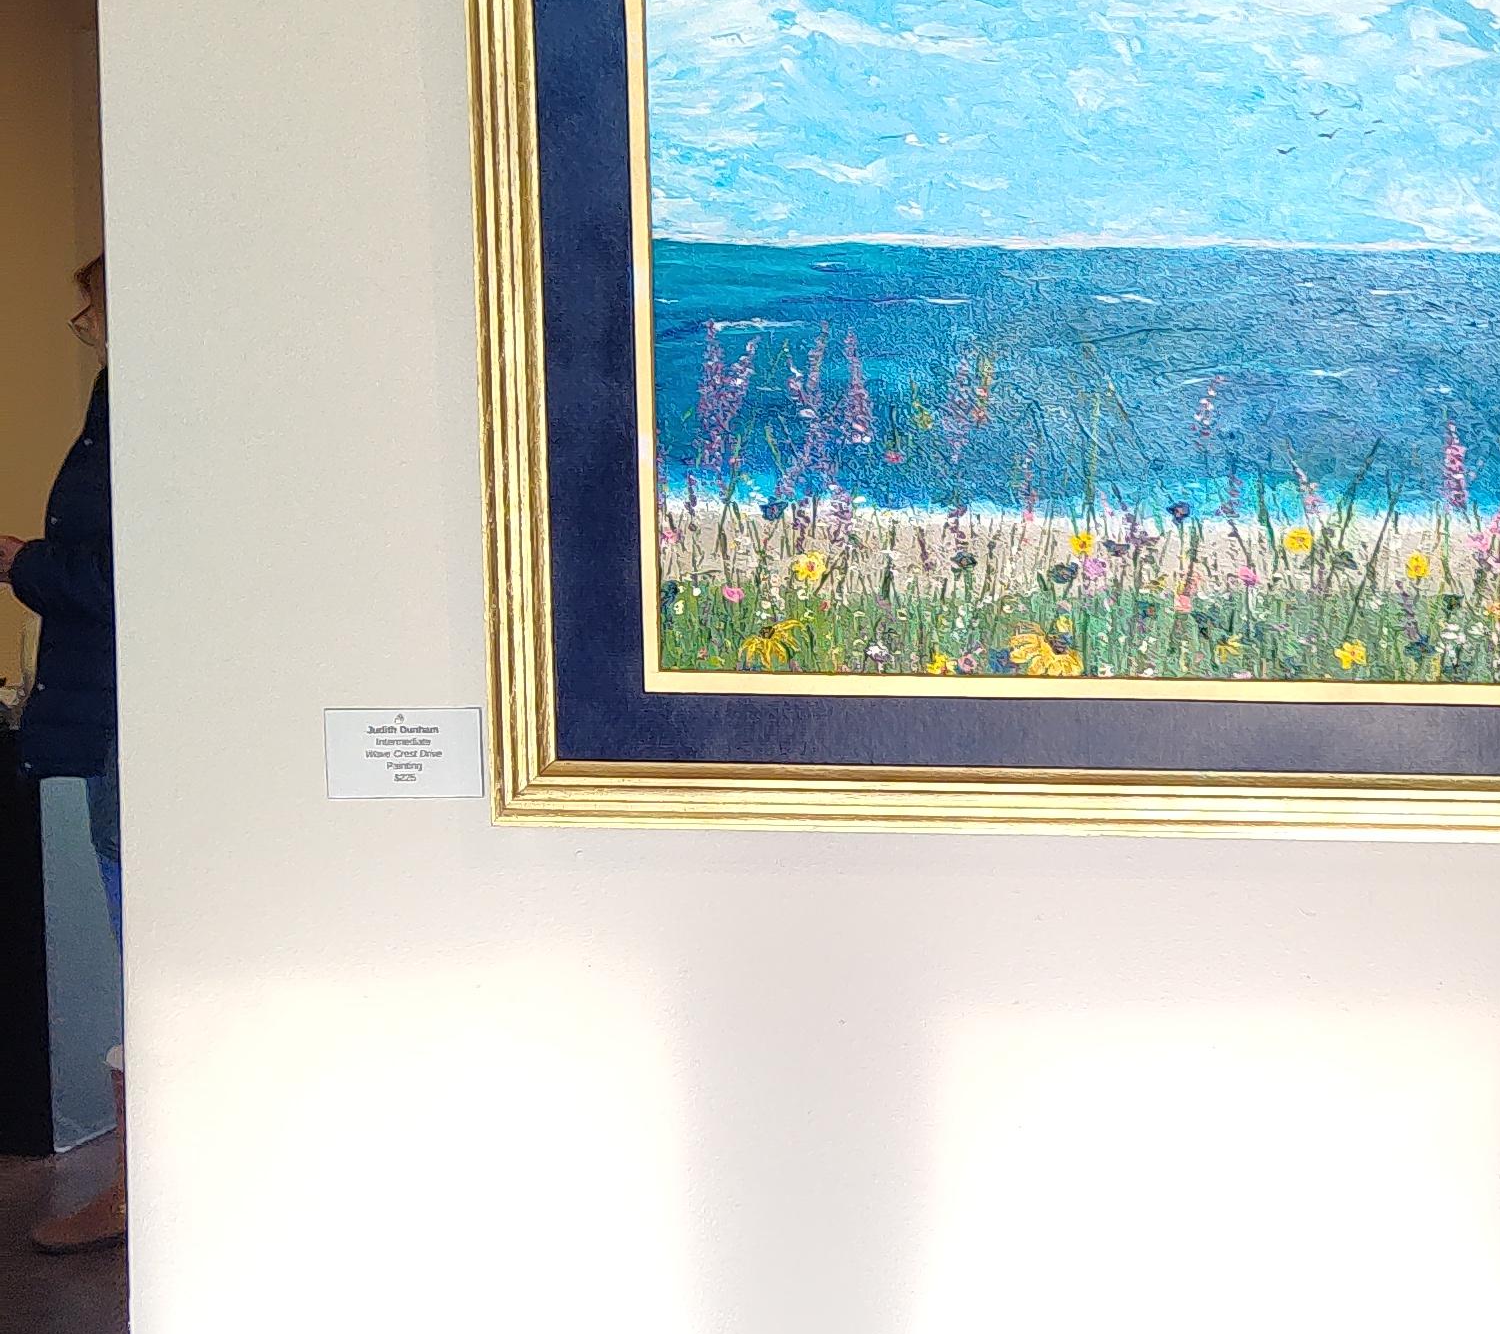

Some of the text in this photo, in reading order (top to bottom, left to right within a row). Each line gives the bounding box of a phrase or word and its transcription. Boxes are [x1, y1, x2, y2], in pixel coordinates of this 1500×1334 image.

[367, 726, 396, 734] Judith
[366, 750, 390, 758] Wave
[387, 762, 422, 771] Painting
